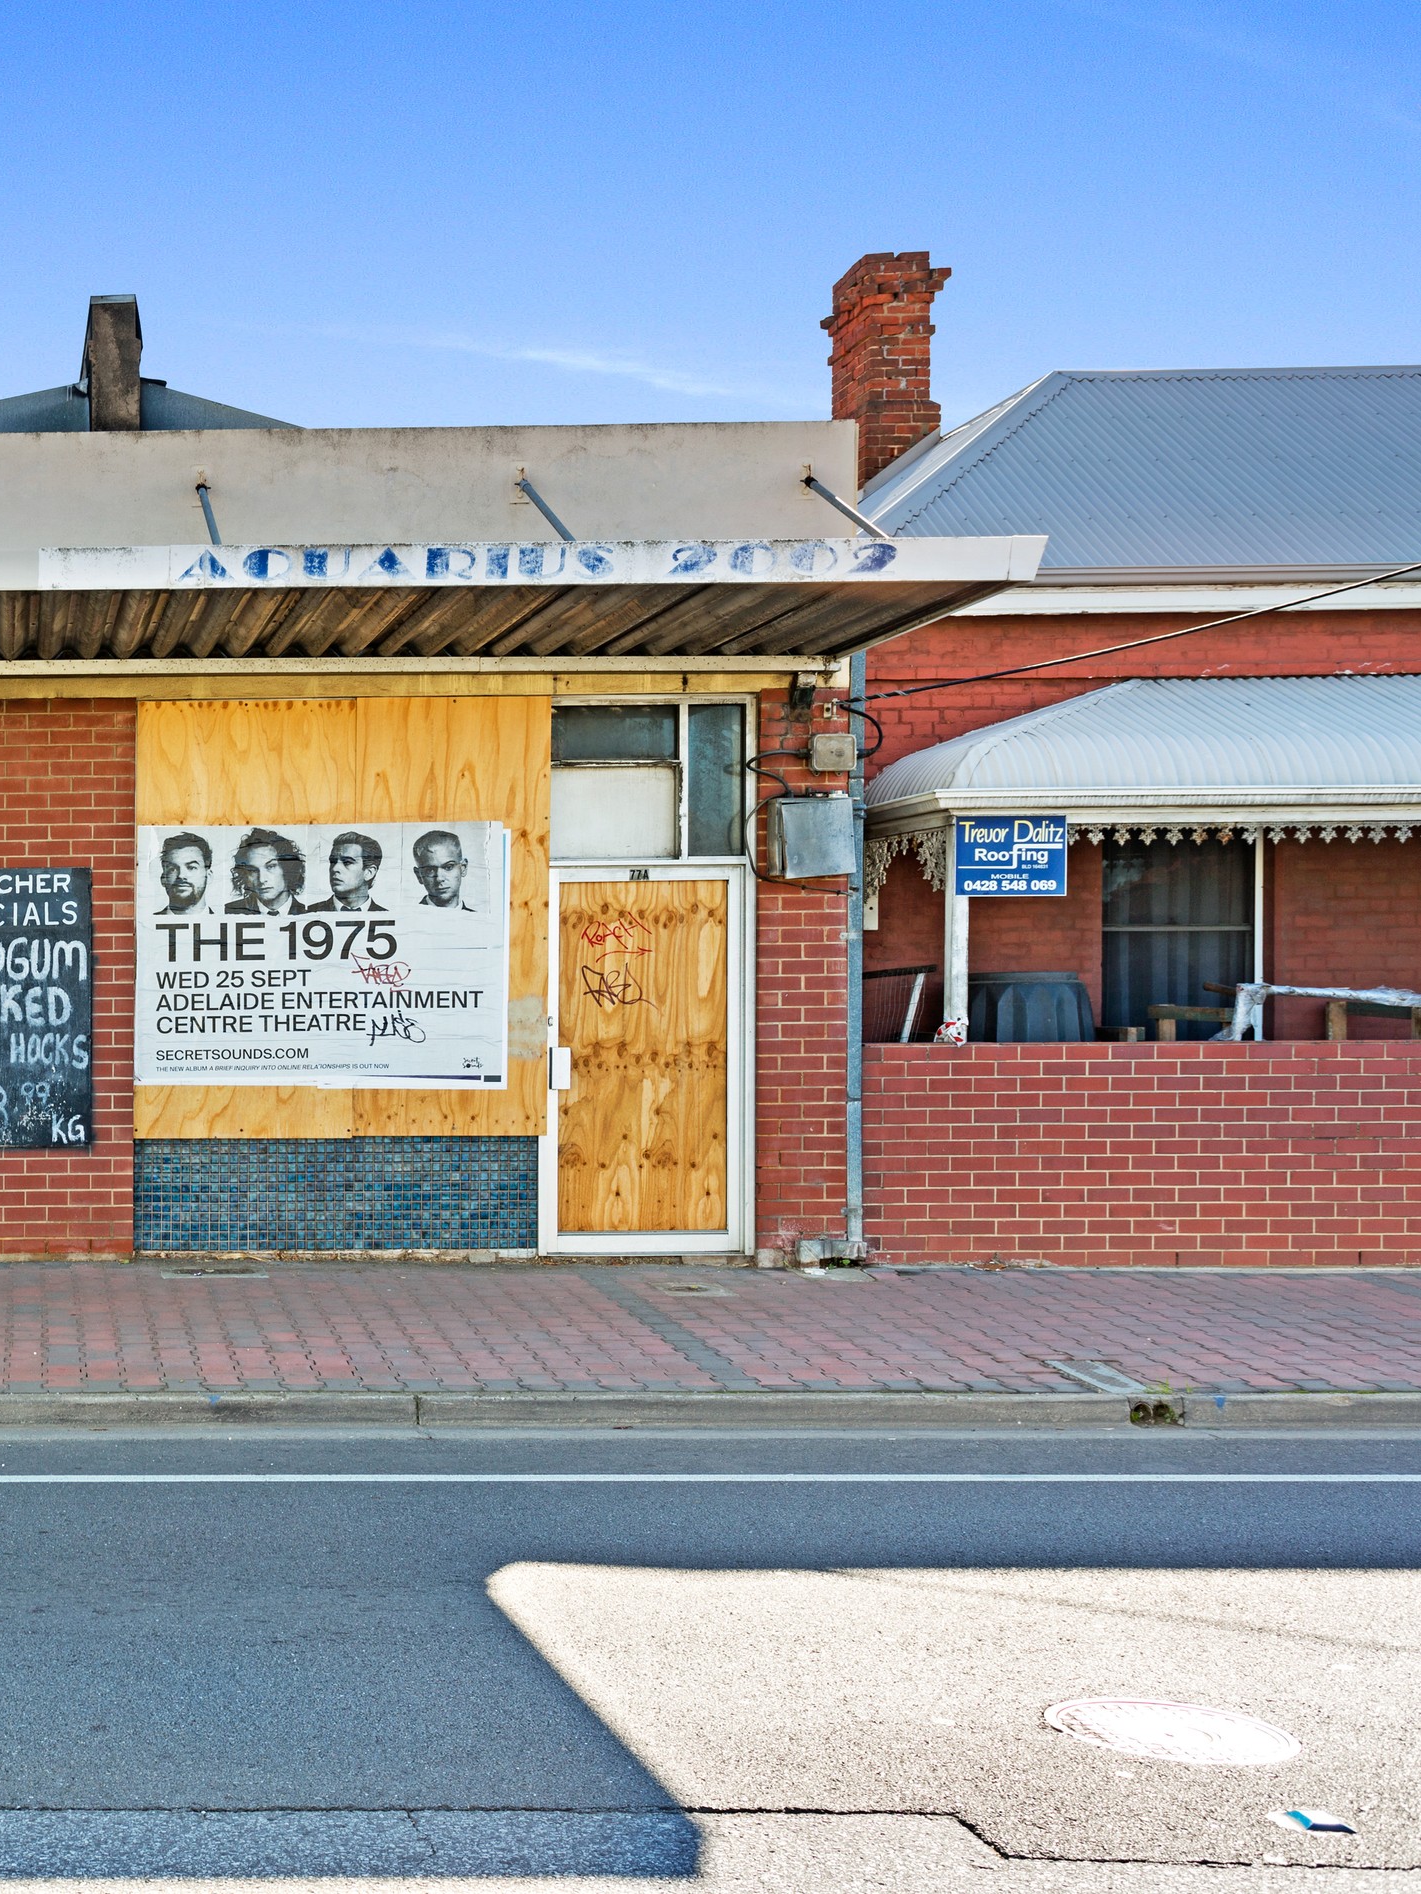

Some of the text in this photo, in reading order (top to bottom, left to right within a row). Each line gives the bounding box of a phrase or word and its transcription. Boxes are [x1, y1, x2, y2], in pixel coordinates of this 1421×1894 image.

[178, 543, 899, 581] AQUARIUS 2002
[959, 820, 1064, 843] Trevor Dalitz
[974, 845, 1049, 864] Roofing
[630, 870, 649, 880] 77A
[964, 880, 1057, 891] 0428 548 069
[156, 920, 398, 962] THE 1975
[581, 912, 653, 949] ROACH
[156, 969, 312, 990] WED 25 SEPT
[156, 990, 484, 1012] ADELAIDE ENTERTAINMENT
[157, 1015, 253, 1034] CENTRE
[259, 1014, 366, 1032] THEATRE
[10, 1032, 89, 1070] HOCKS
[156, 1048, 310, 1061] SECRETSOUNDS.COM
[50, 1114, 86, 1144] KG
